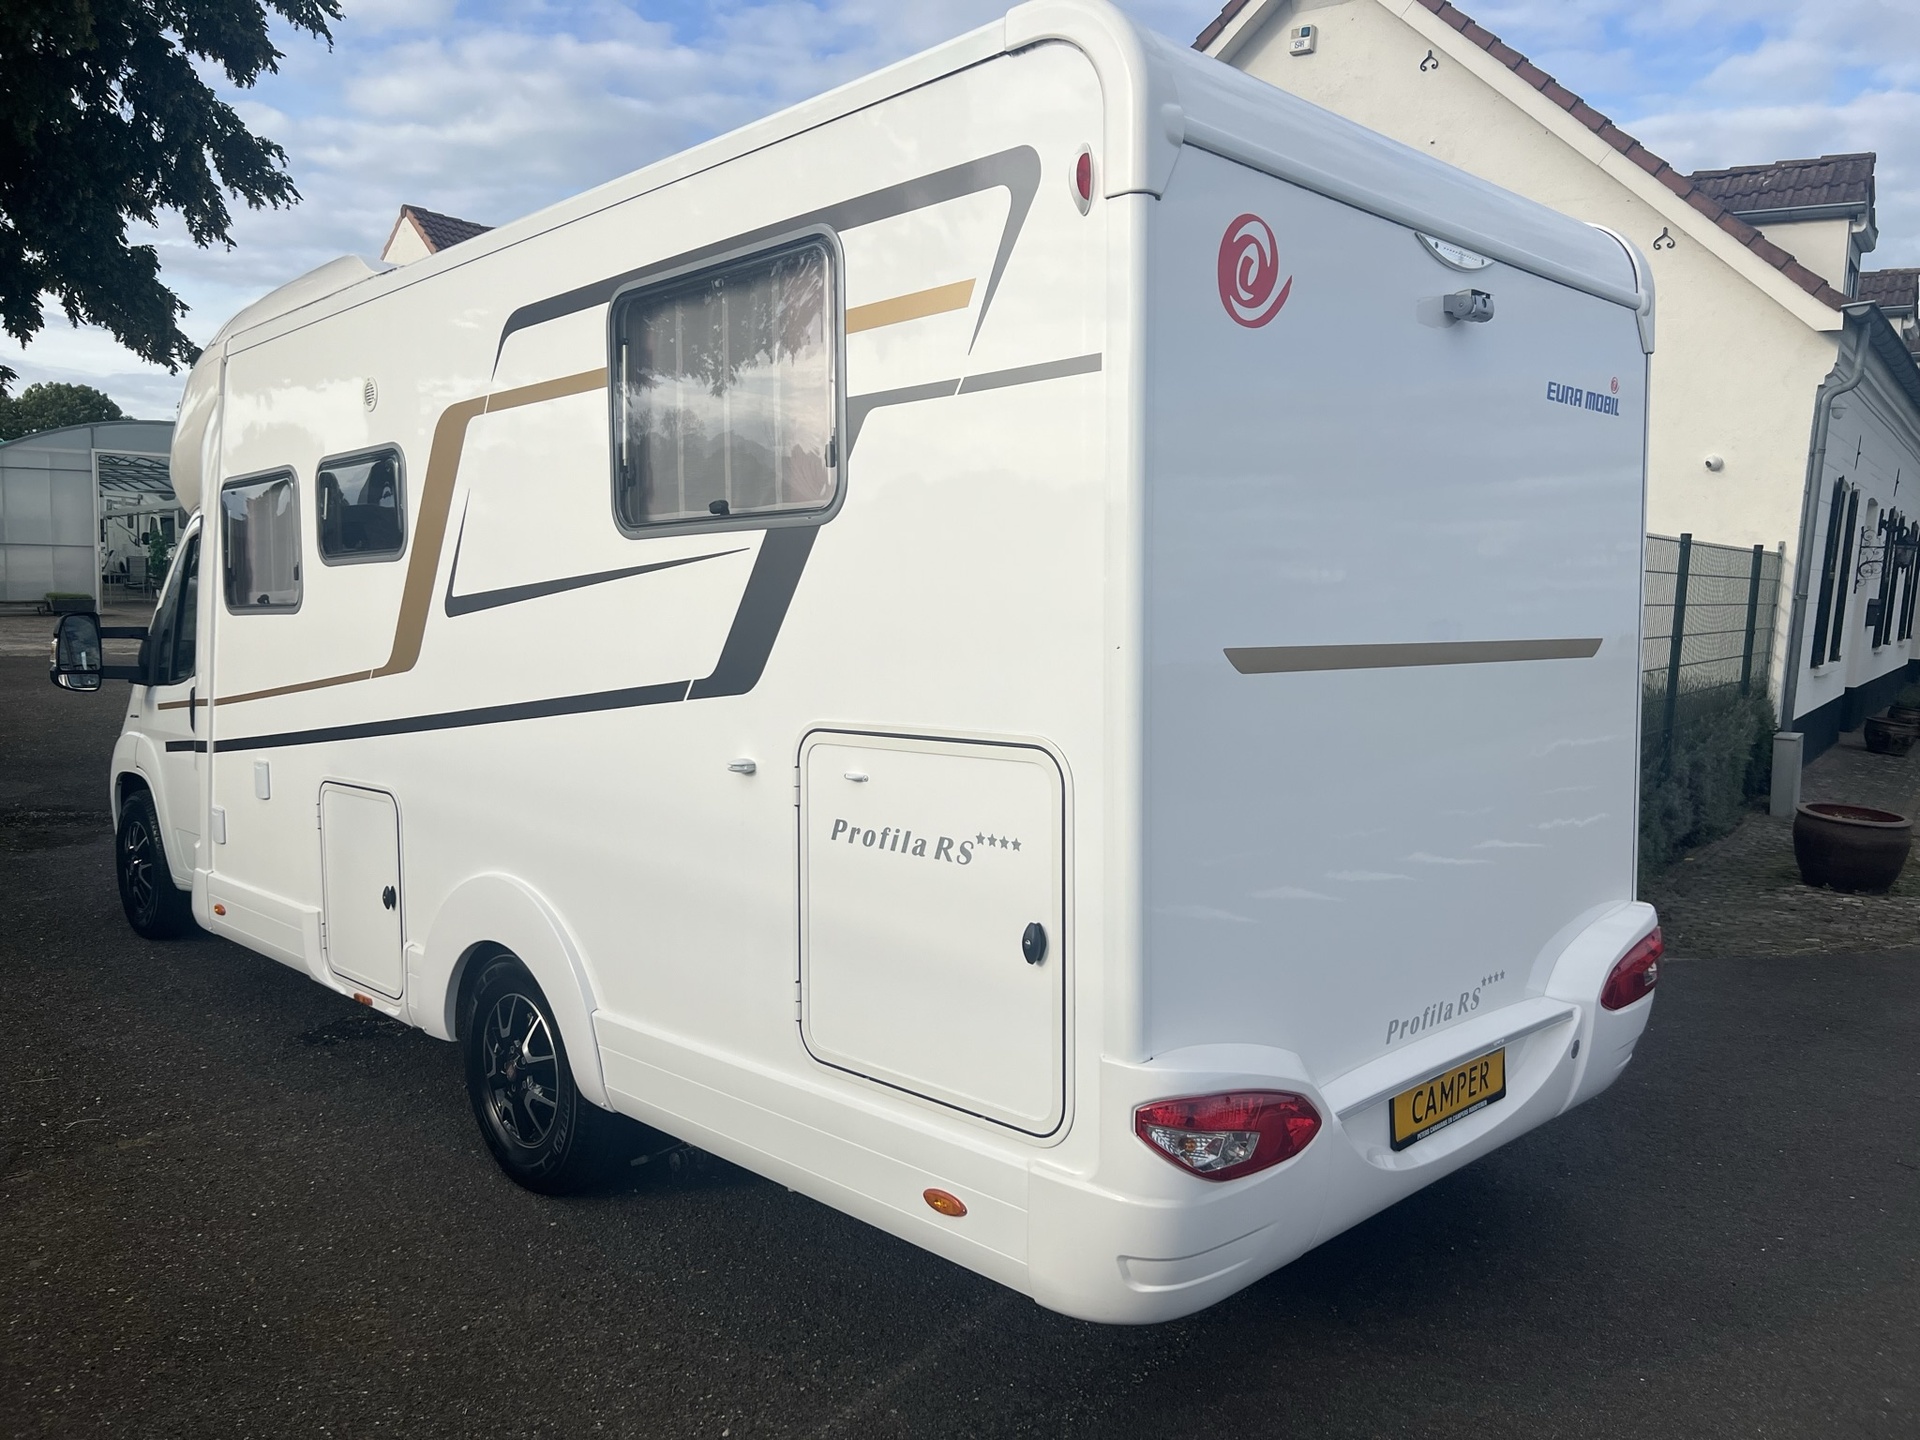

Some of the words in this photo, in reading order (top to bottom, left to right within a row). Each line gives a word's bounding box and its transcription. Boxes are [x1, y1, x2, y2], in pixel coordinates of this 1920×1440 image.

[1546, 381, 1583, 408] EURA
[1584, 391, 1620, 417] MOBIL
[830, 818, 927, 857] Profila
[1385, 1000, 1454, 1045] Profila
[1411, 1060, 1489, 1124] CAMPER
